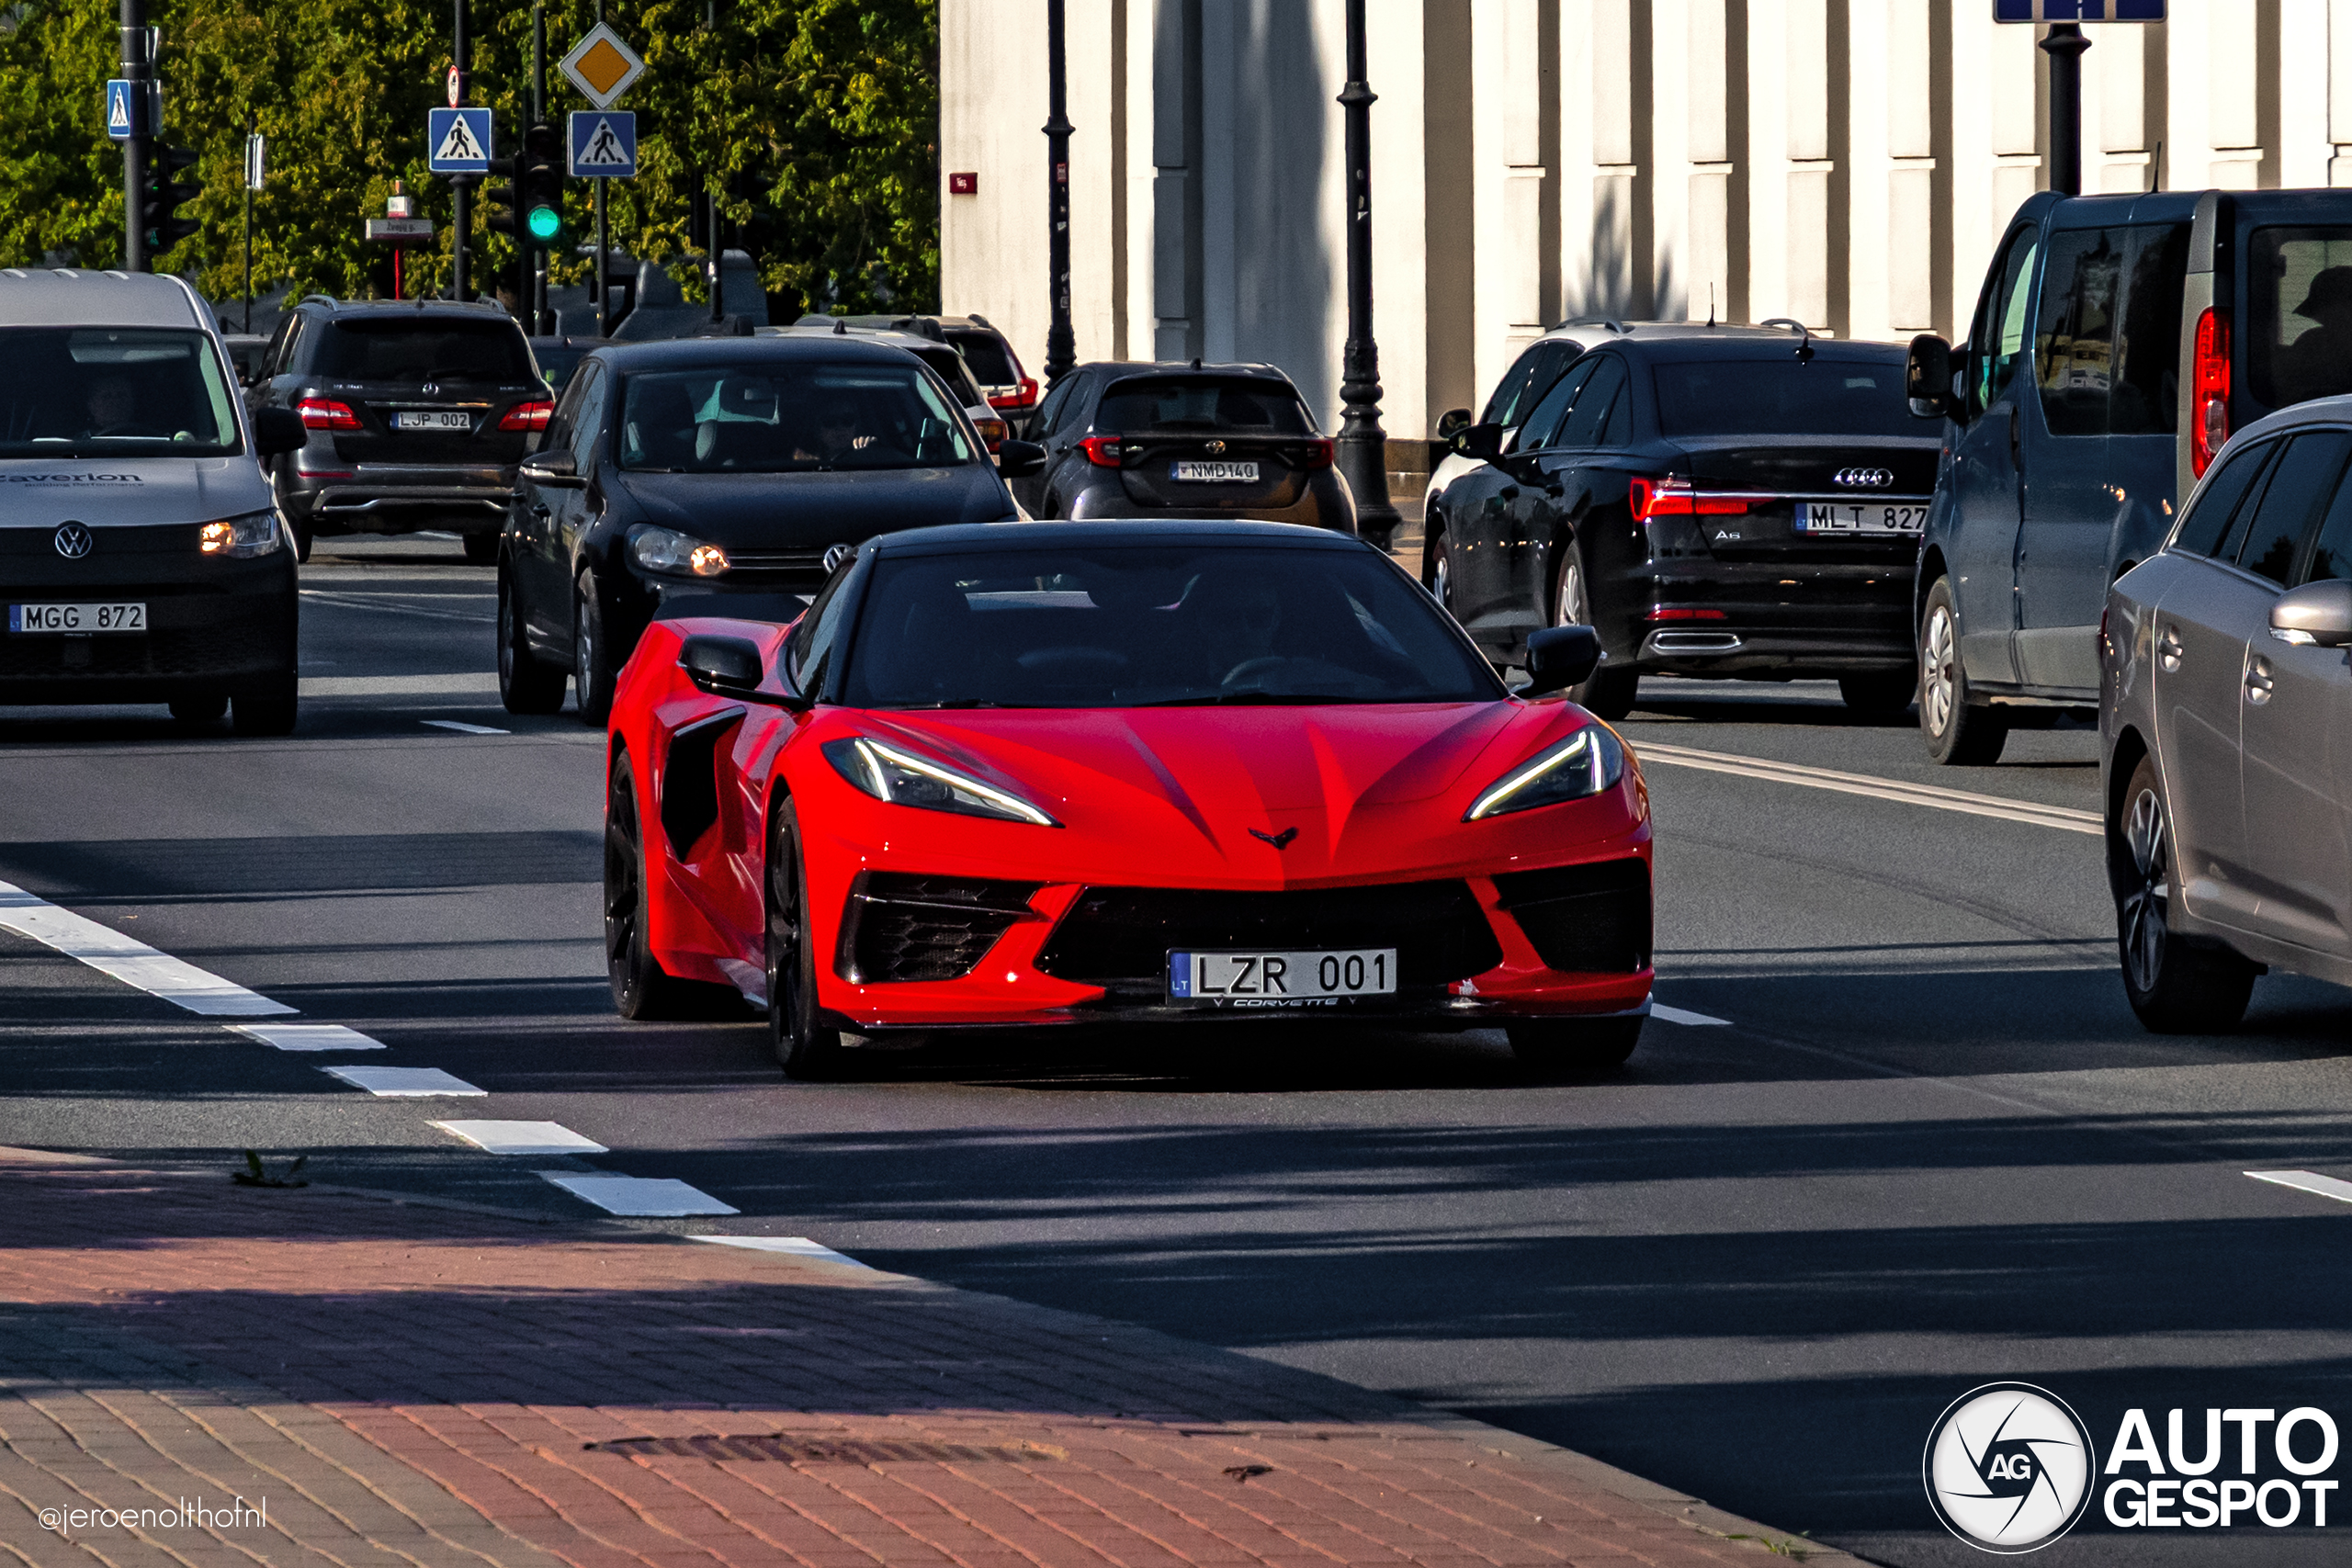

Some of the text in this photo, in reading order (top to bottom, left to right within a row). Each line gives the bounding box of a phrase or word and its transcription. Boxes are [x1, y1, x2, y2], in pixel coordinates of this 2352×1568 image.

[400, 412, 469, 427] LJP 002
[1811, 505, 1928, 530] MLT 827
[10, 620, 20, 629] LT
[26, 605, 142, 629] MGG 872
[1197, 953, 1386, 995] LZR 001
[1171, 979, 1189, 991] LT
[1233, 998, 1340, 1008] CORVETTE
